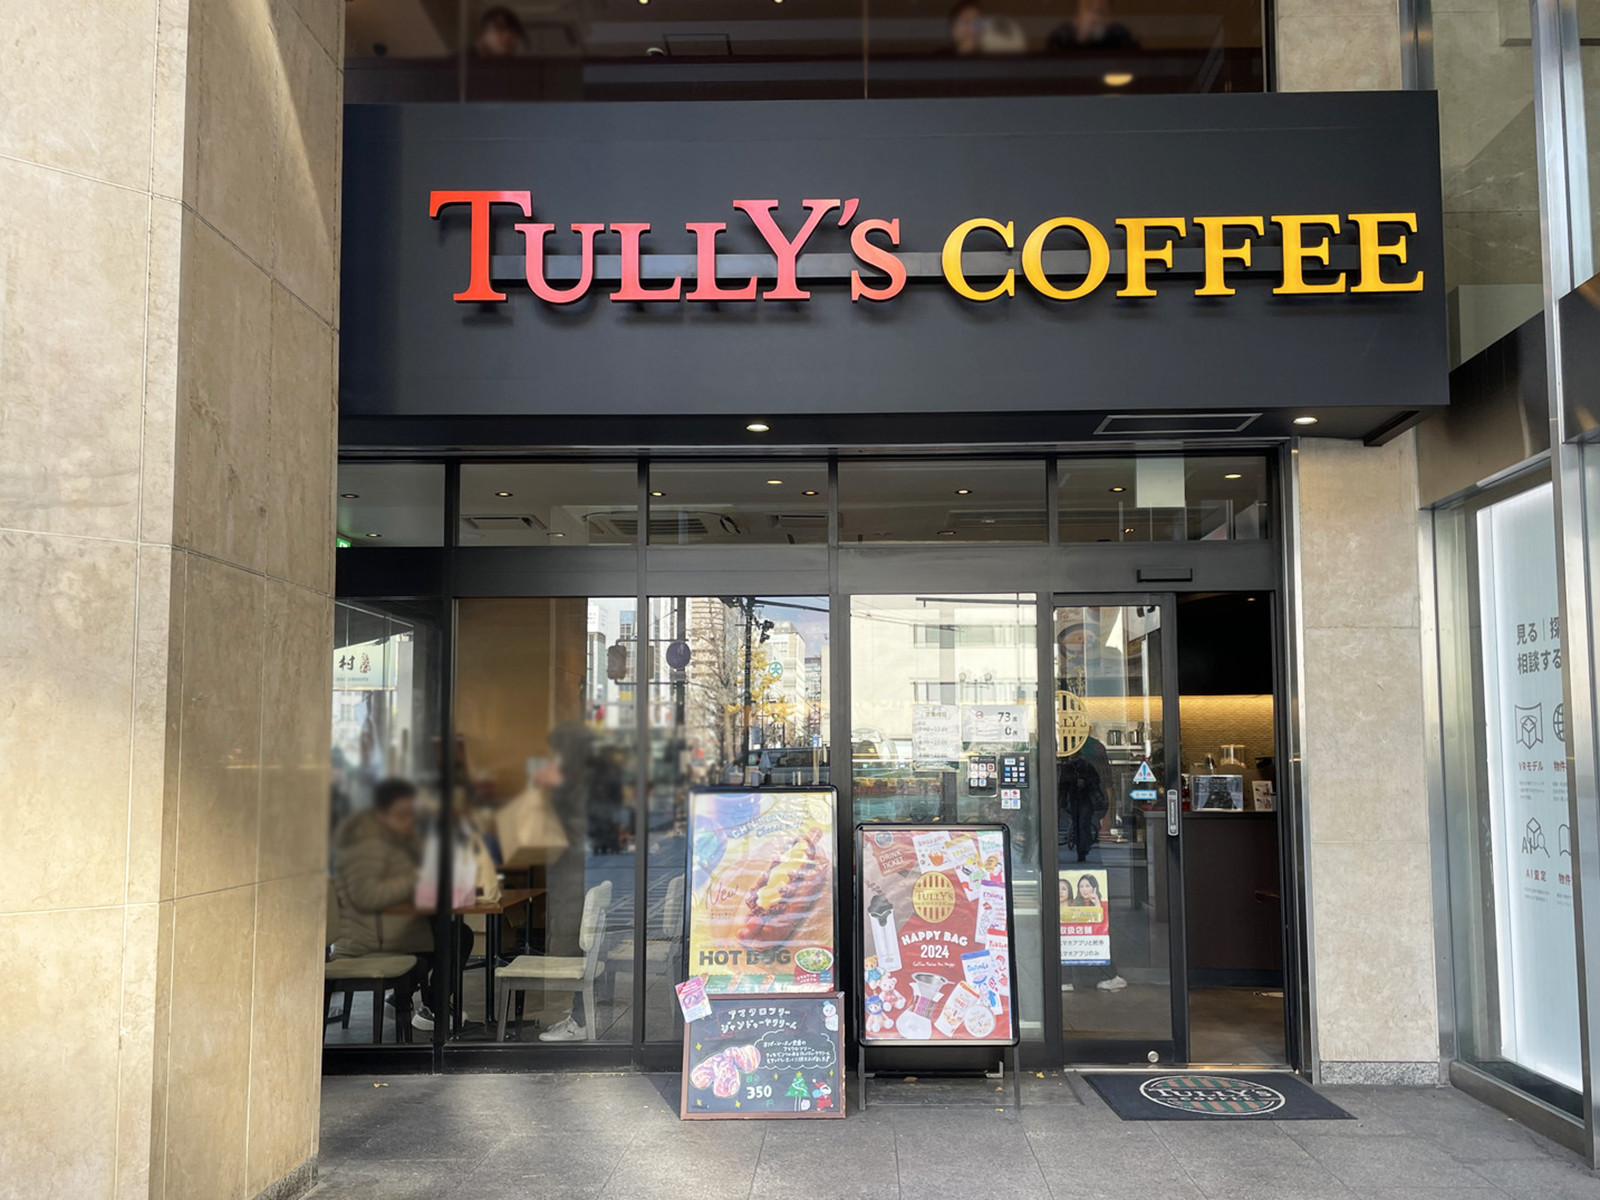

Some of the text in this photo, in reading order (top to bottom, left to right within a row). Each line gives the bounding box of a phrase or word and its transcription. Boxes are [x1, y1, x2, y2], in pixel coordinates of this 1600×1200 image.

[941, 212, 1424, 301] COFFEE
[1516, 622, 1538, 646] 見る
[1516, 648, 1562, 676] 相談する
[880, 849, 902, 863] DRINK
[881, 856, 904, 869] TICKET
[901, 930, 968, 946] HAPPY BAG
[699, 949, 791, 966] HOT DOG
[920, 944, 950, 959] 2024
[746, 1085, 773, 1100] 350
